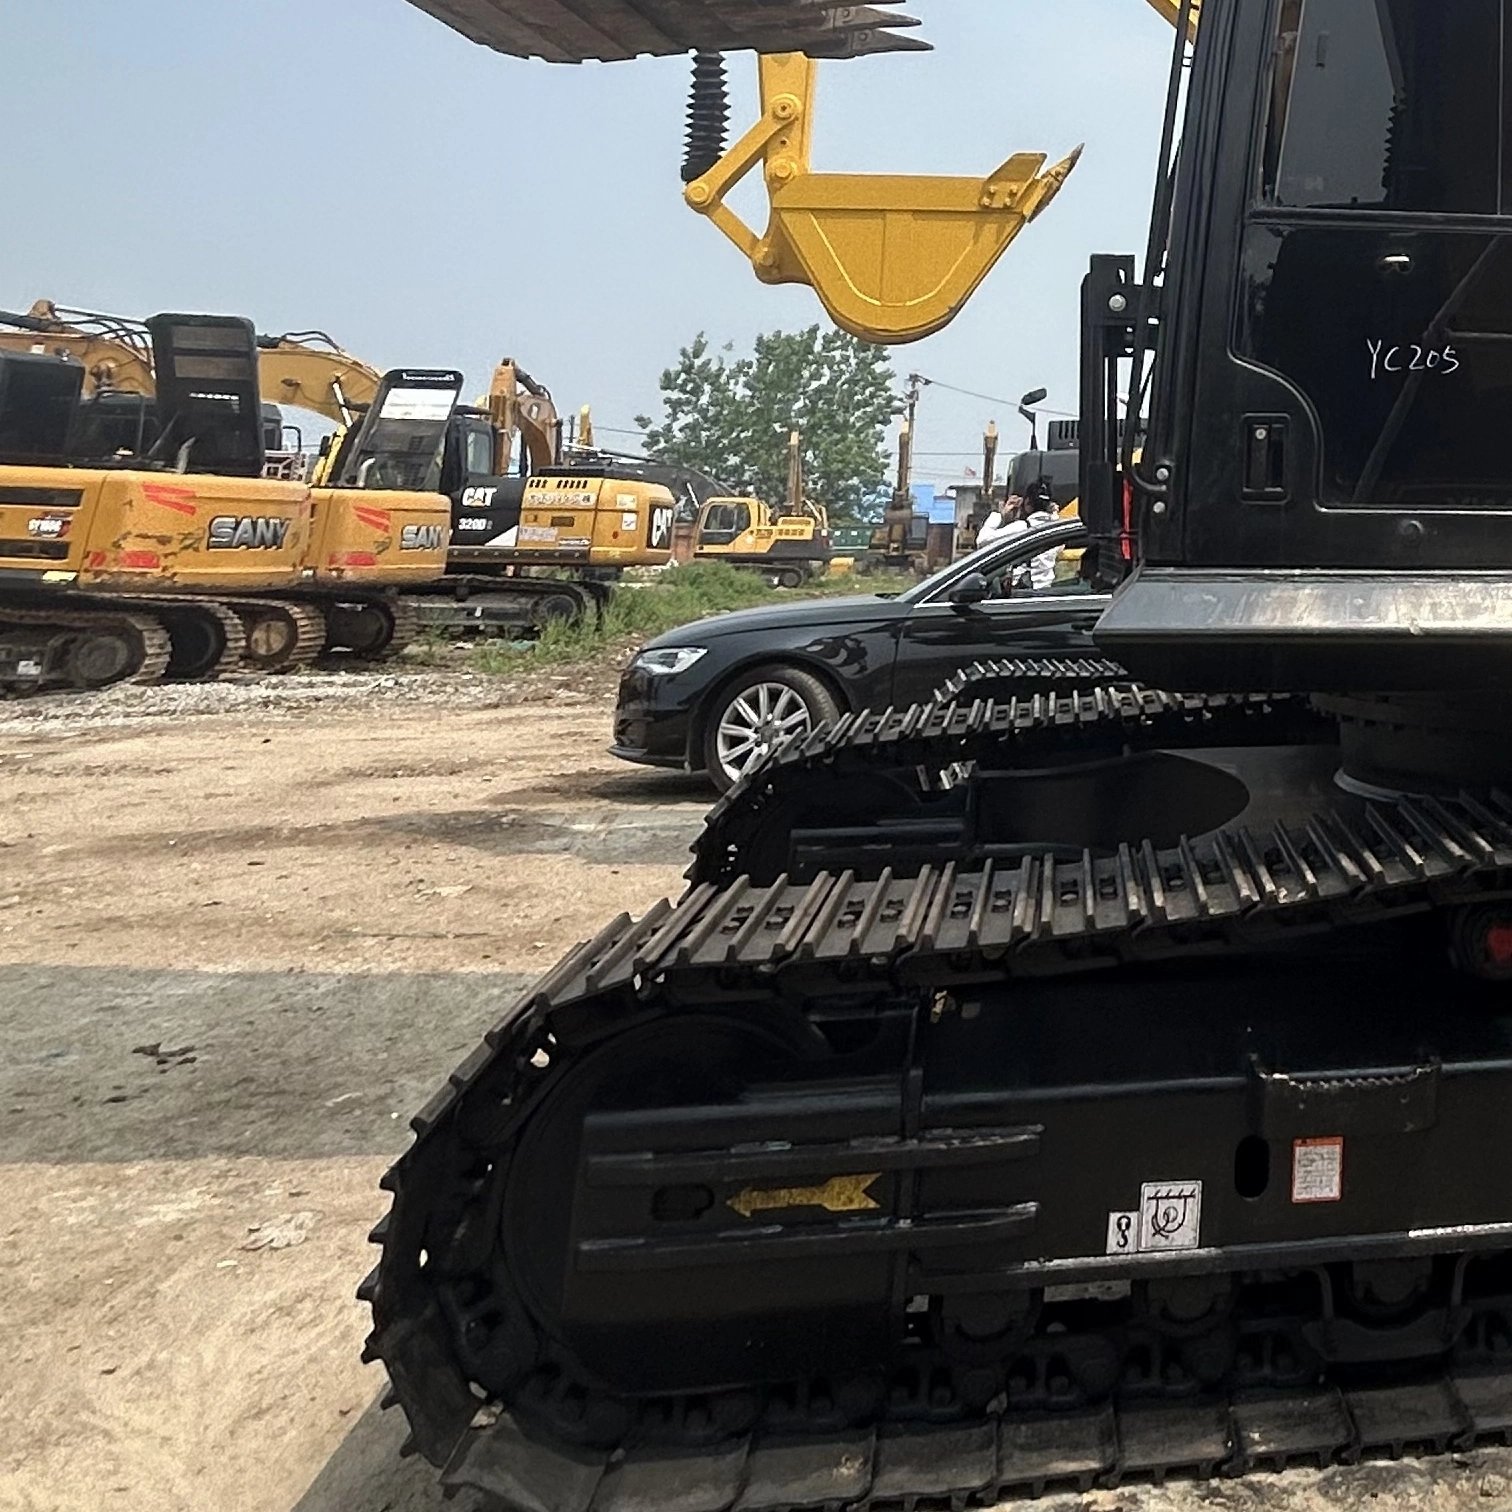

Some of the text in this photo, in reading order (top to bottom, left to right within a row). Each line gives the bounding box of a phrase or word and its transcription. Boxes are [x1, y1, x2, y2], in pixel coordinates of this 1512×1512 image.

[1366, 338, 1459, 379] YC205
[462, 486, 498, 507] CAT
[207, 515, 292, 550] SANY
[651, 507, 673, 547] CAT
